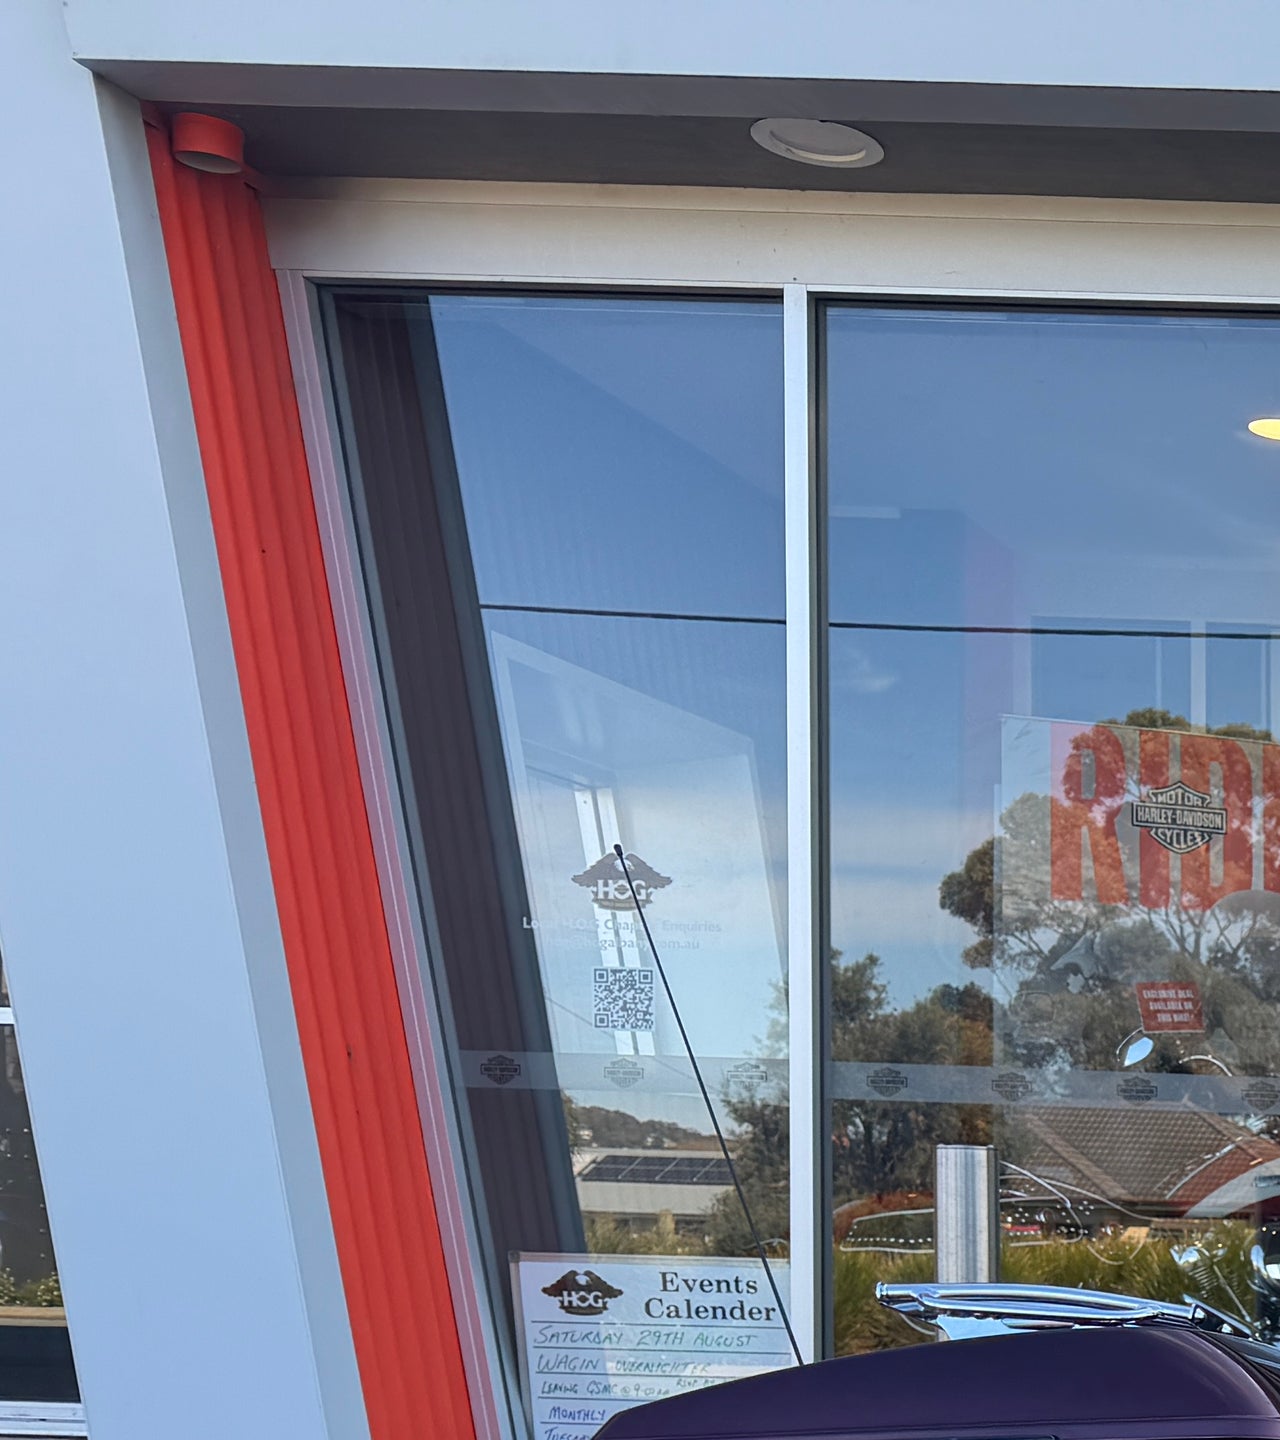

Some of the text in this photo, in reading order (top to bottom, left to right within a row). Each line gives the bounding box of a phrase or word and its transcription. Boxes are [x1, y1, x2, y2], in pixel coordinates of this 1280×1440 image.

[1157, 787, 1202, 807] MOTOR
[1137, 806, 1222, 828] HARLEY-DAVIDSON
[1158, 828, 1202, 849] CYCLES
[659, 1271, 758, 1295] Events
[562, 1290, 603, 1308] HOG
[644, 1297, 776, 1322] Calender
[534, 1325, 758, 1347] SATURDAY 29TH AUGUST
[538, 1355, 599, 1372] WAGIN
[549, 1406, 606, 1421] MONTHLY
